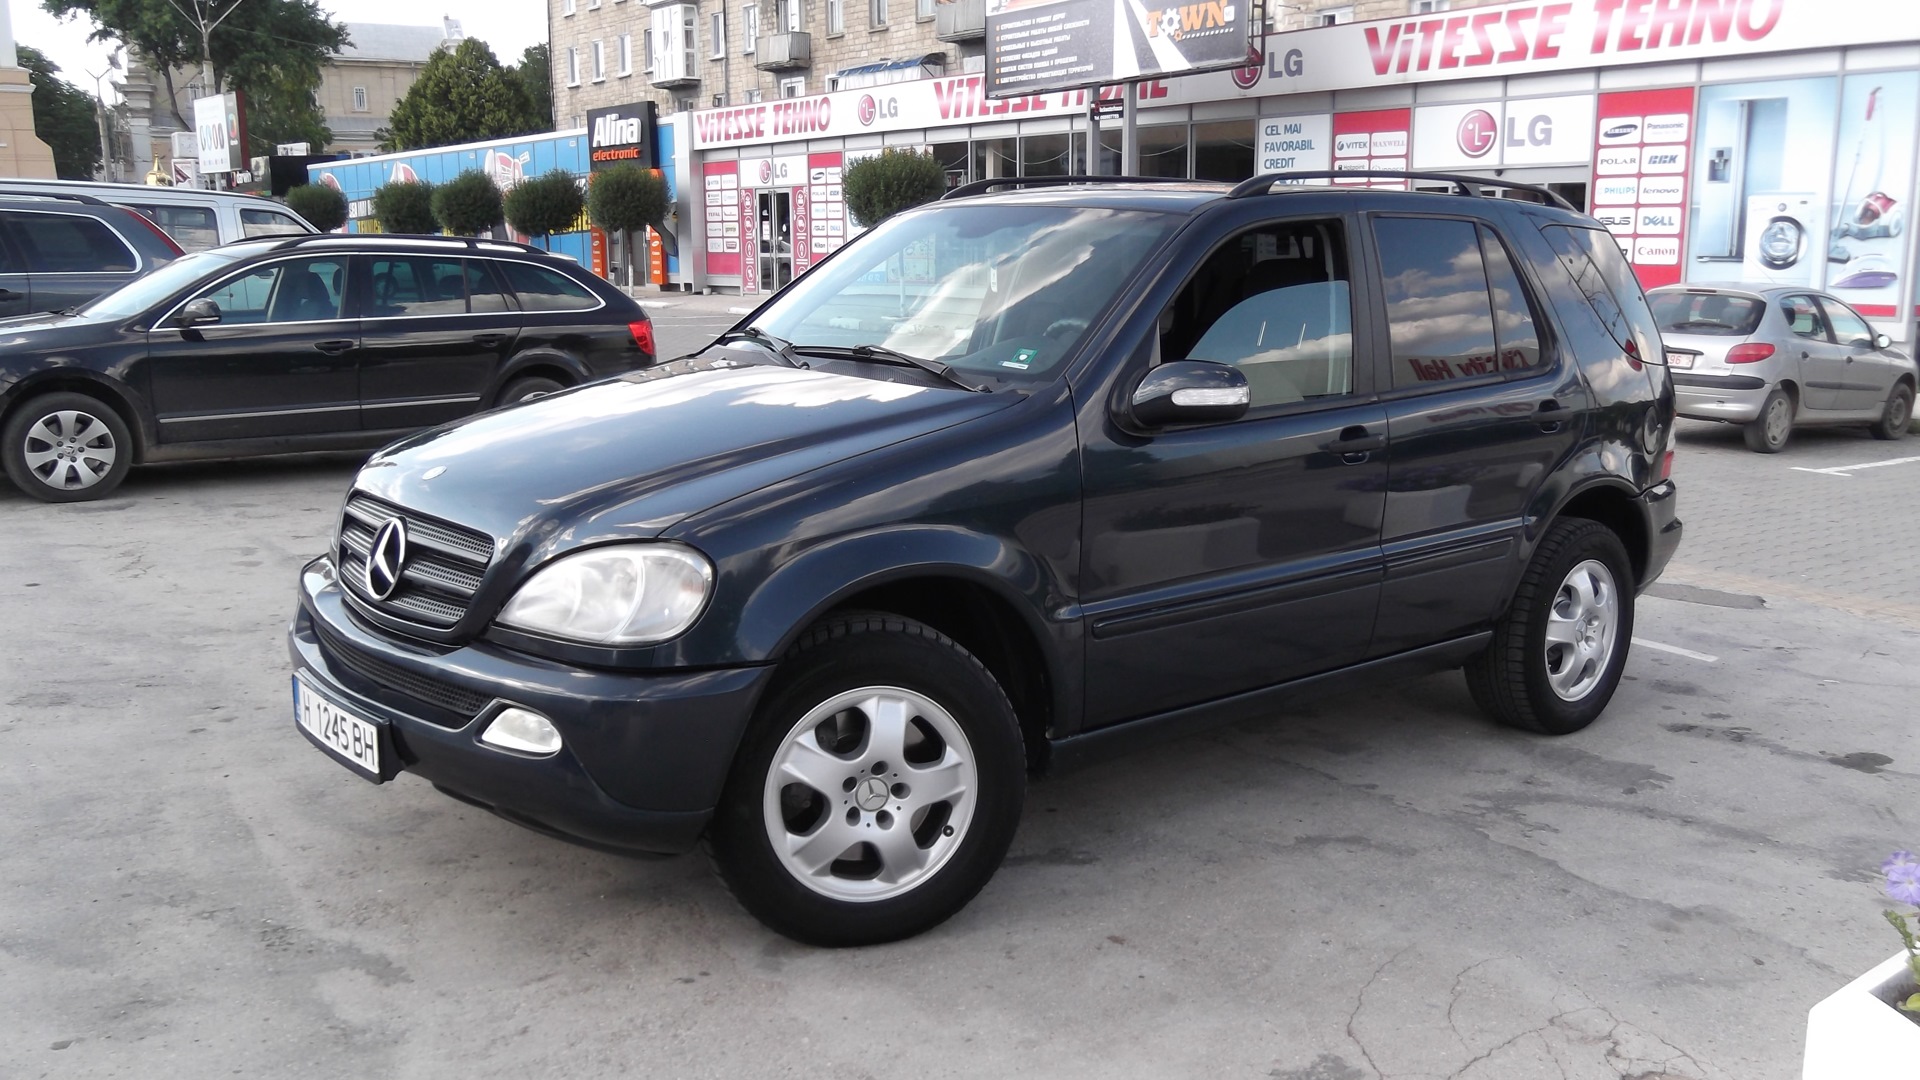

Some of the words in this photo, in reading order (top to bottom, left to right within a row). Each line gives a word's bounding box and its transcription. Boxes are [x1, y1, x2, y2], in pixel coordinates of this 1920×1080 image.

[1590, 0, 1783, 54] TEHNO
[1268, 49, 1303, 79] LG
[879, 96, 898, 119] LG
[773, 96, 831, 136] TEHNO
[592, 113, 643, 147] Alina
[1265, 125, 1281, 136] CEL
[1284, 123, 1302, 135] MAI
[1506, 114, 1552, 147] LG
[1264, 140, 1314, 152] FAVORABIL
[1346, 141, 1368, 149] VITEK
[1372, 140, 1405, 148] MAXWELL
[592, 147, 639, 162] electronic
[774, 162, 788, 178] LG
[1264, 157, 1296, 169] CREDIT
[1599, 216, 1631, 225] ASUS
[1642, 216, 1674, 226] DELL
[1638, 246, 1675, 255] Canon
[303, 690, 311, 726] H
[317, 702, 350, 750] 1245
[352, 721, 375, 766] BH
